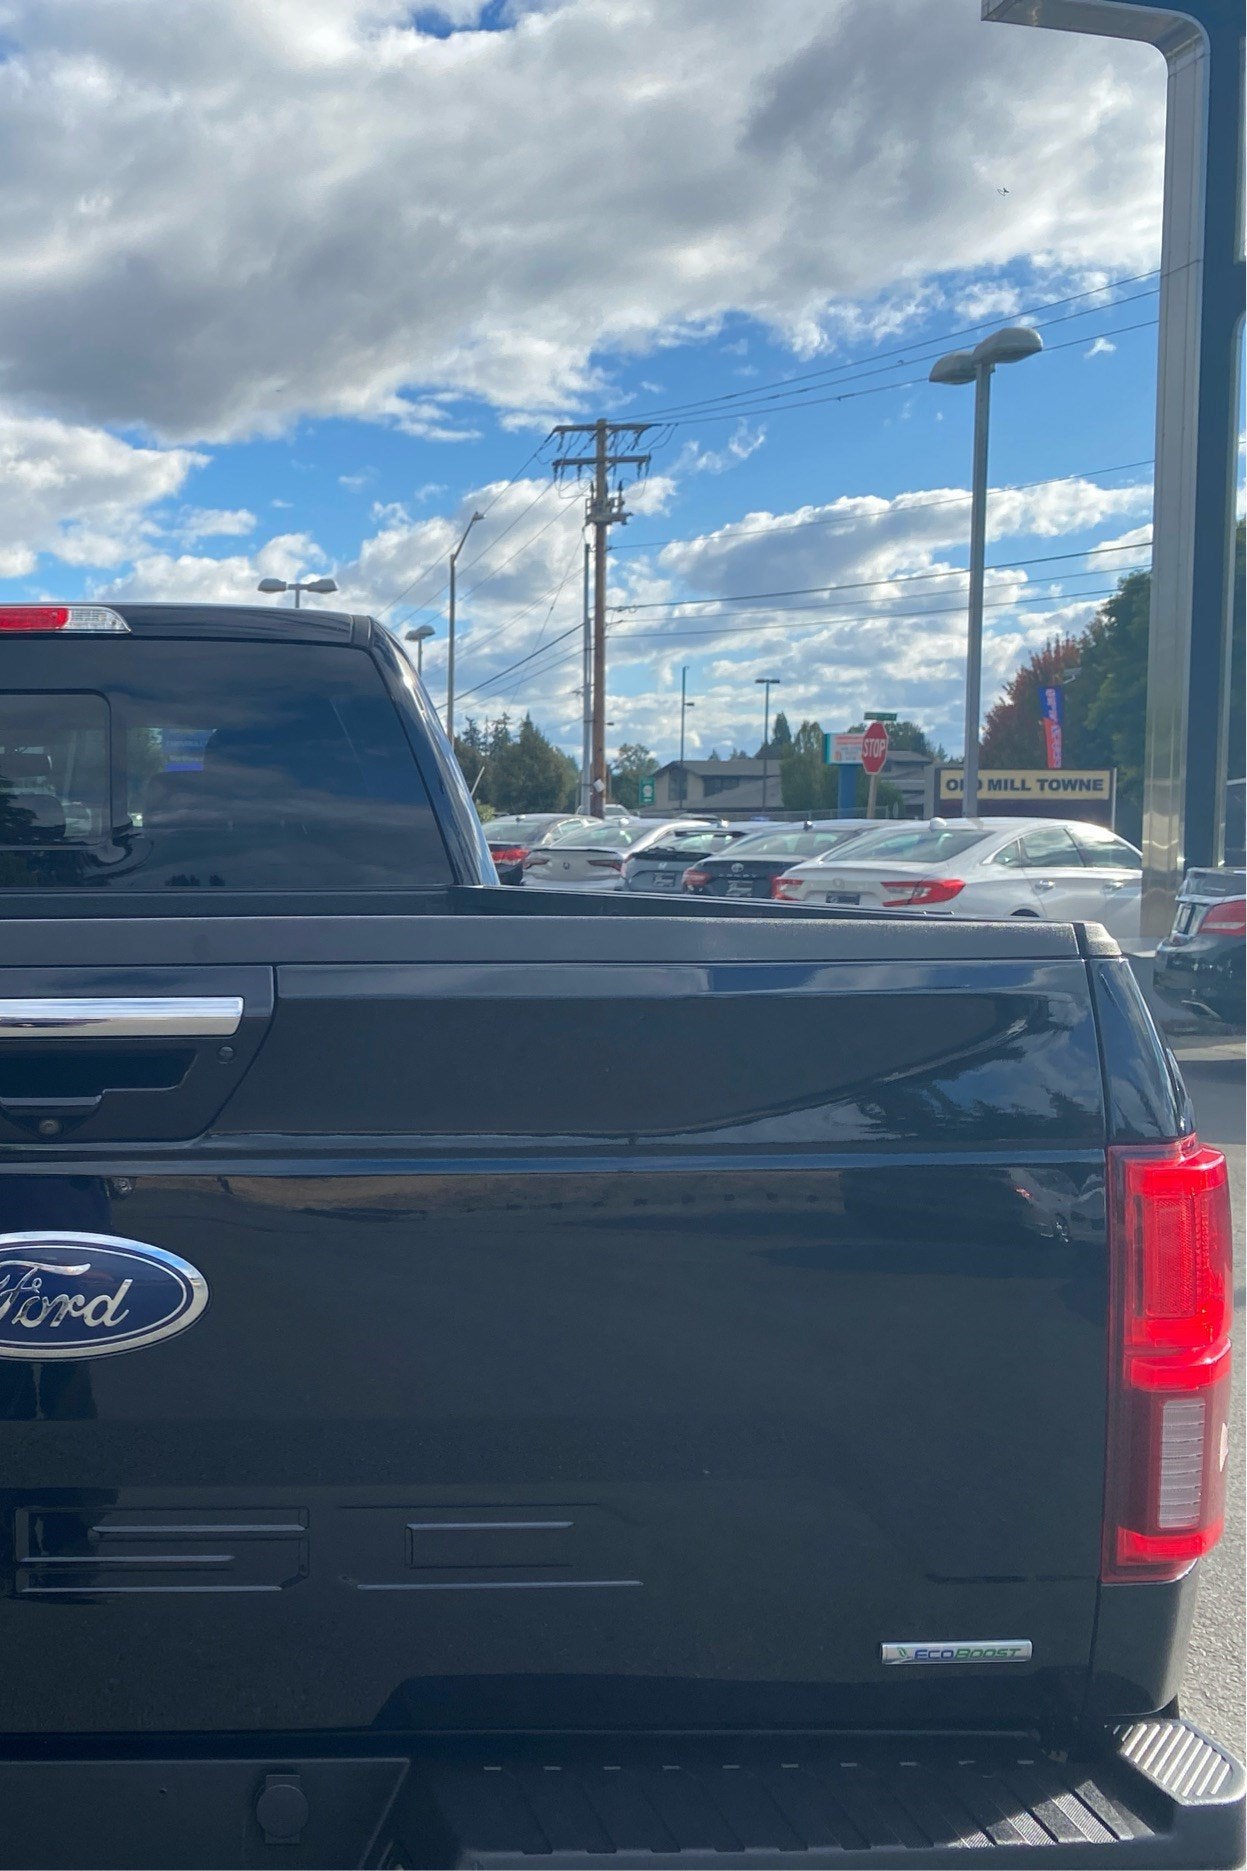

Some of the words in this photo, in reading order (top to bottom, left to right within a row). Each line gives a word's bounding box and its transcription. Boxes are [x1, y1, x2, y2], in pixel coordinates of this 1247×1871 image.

[863, 738, 886, 758] STOP
[987, 778, 1032, 791] MILL
[1037, 778, 1104, 792] TOWNE
